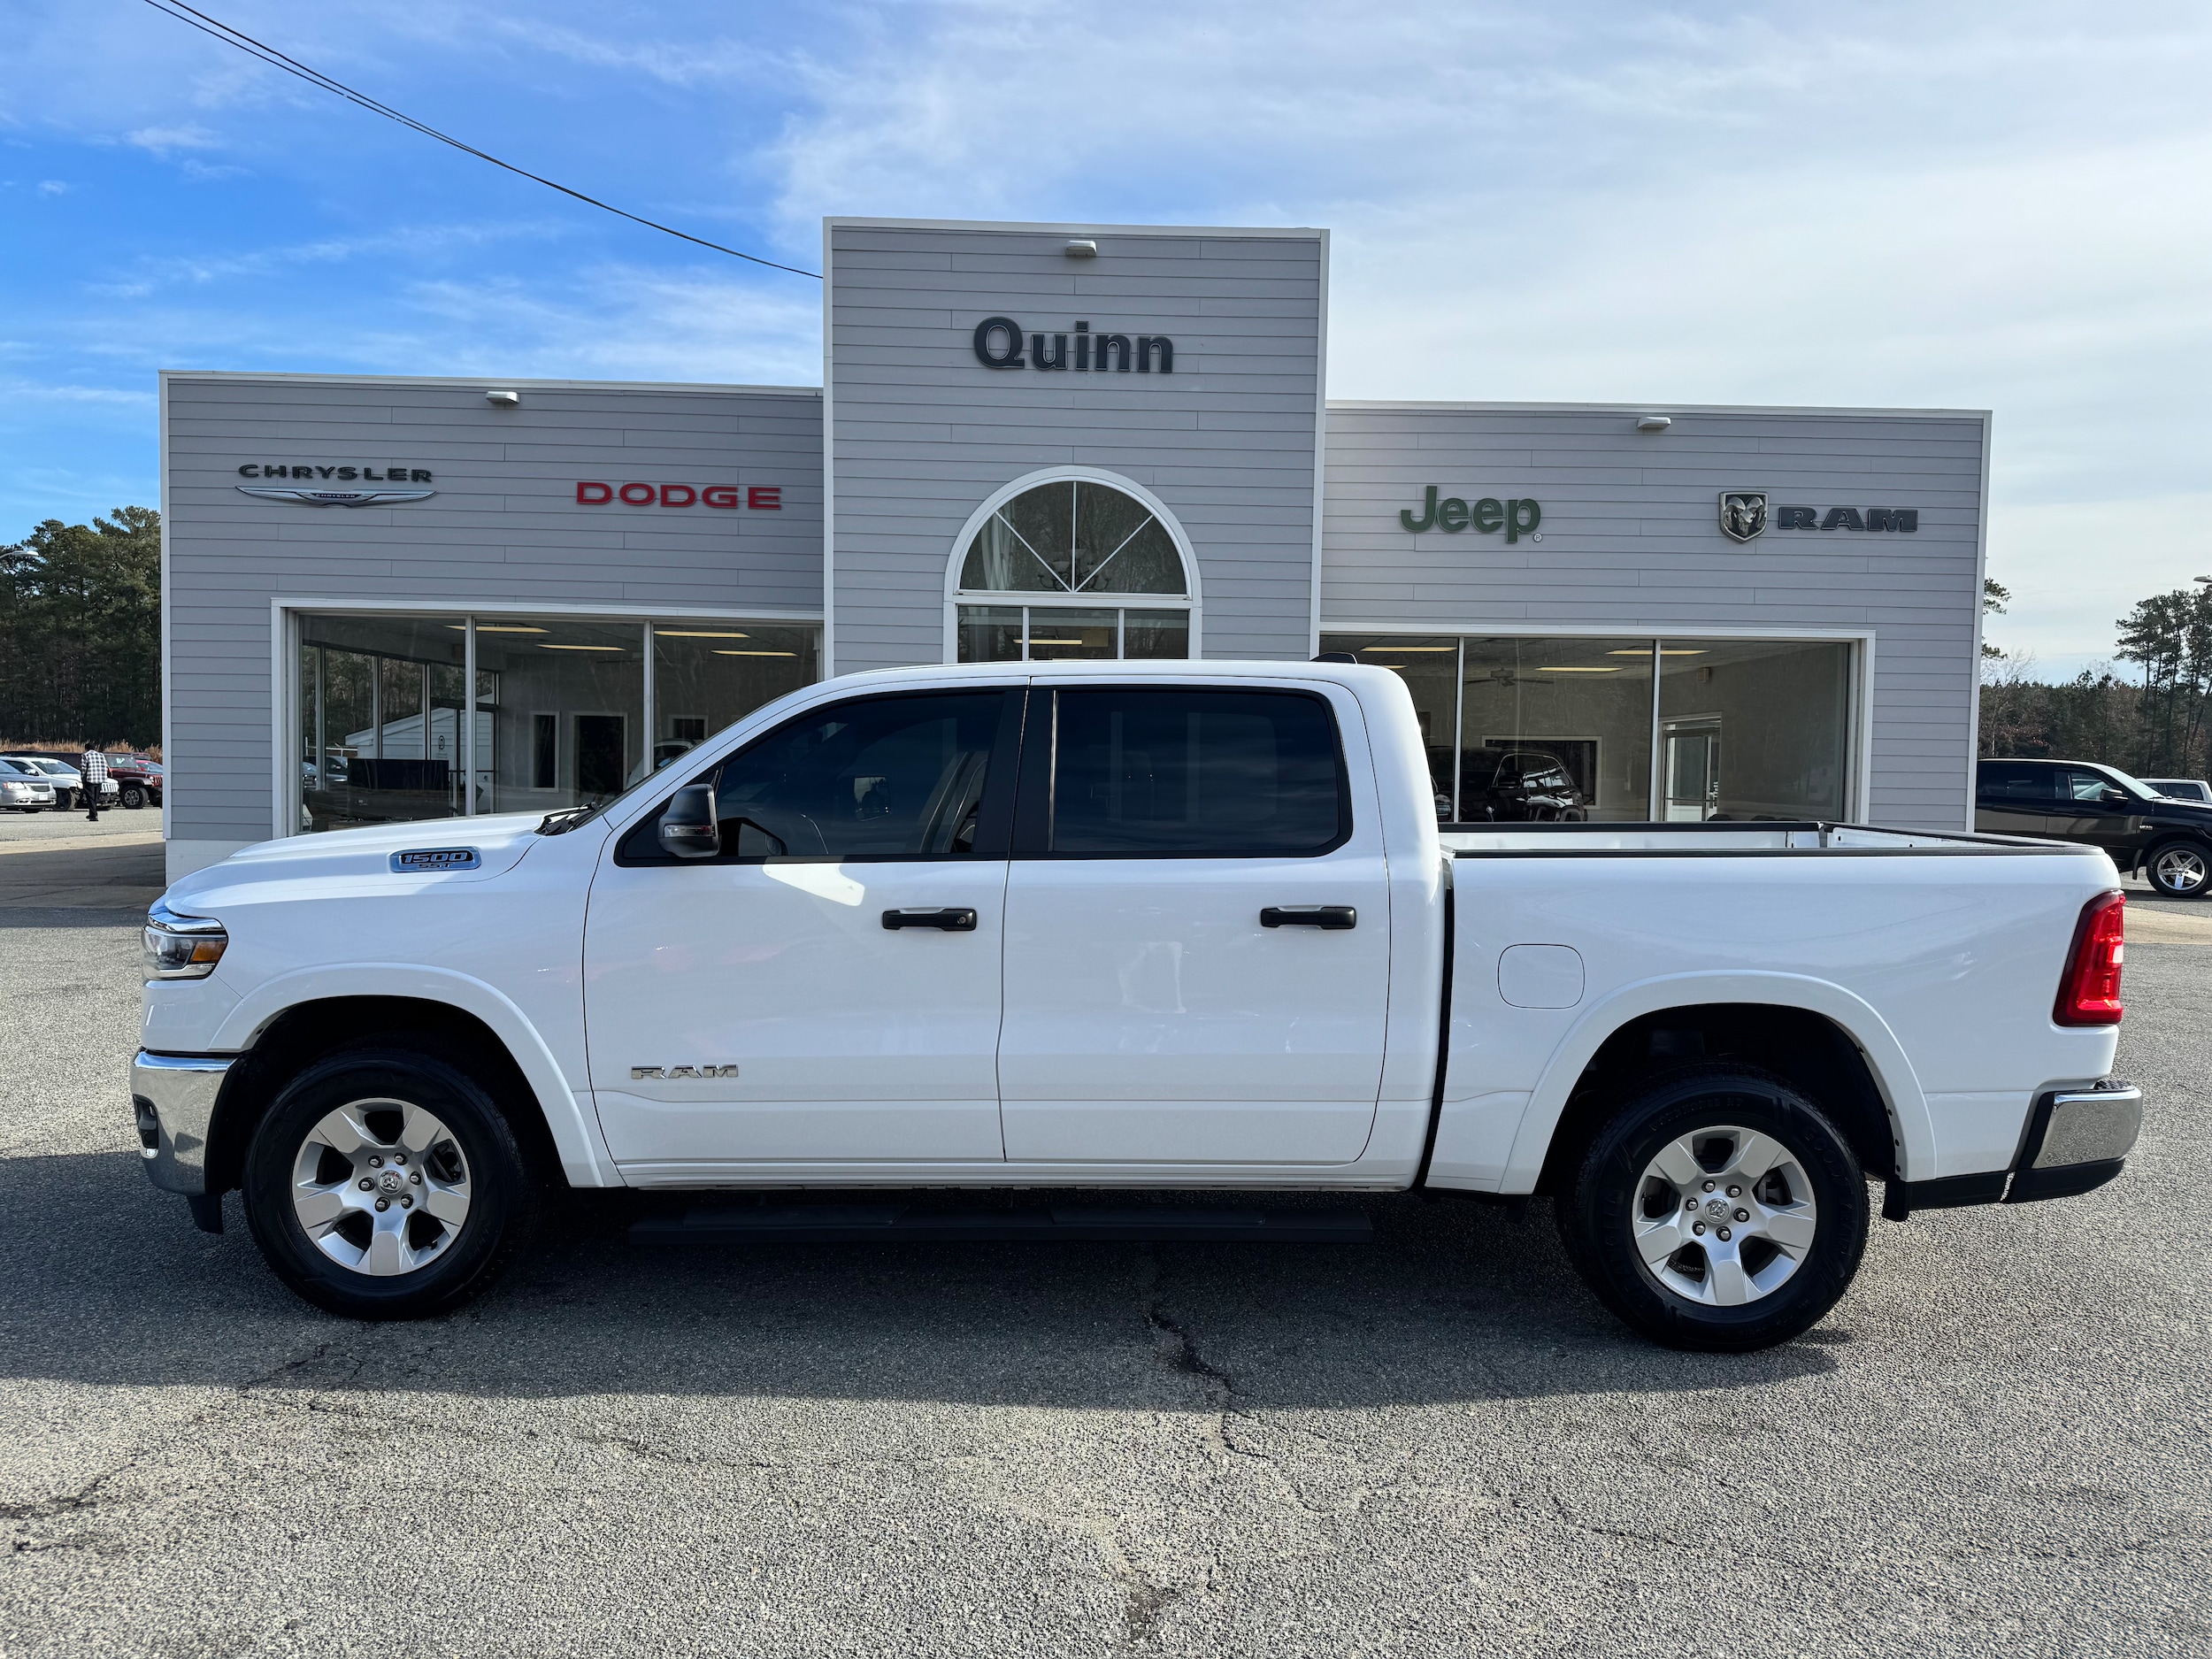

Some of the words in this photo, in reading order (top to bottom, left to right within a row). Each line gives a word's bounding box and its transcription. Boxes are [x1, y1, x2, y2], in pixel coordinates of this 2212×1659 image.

[973, 316, 1173, 373] Quinn
[238, 464, 432, 483] CHRYSLER
[576, 481, 782, 511] DODGE
[1400, 485, 1541, 544] Jeep
[1778, 506, 1918, 532] RAM
[404, 852, 468, 864] 1500
[631, 1064, 739, 1079] RAM
